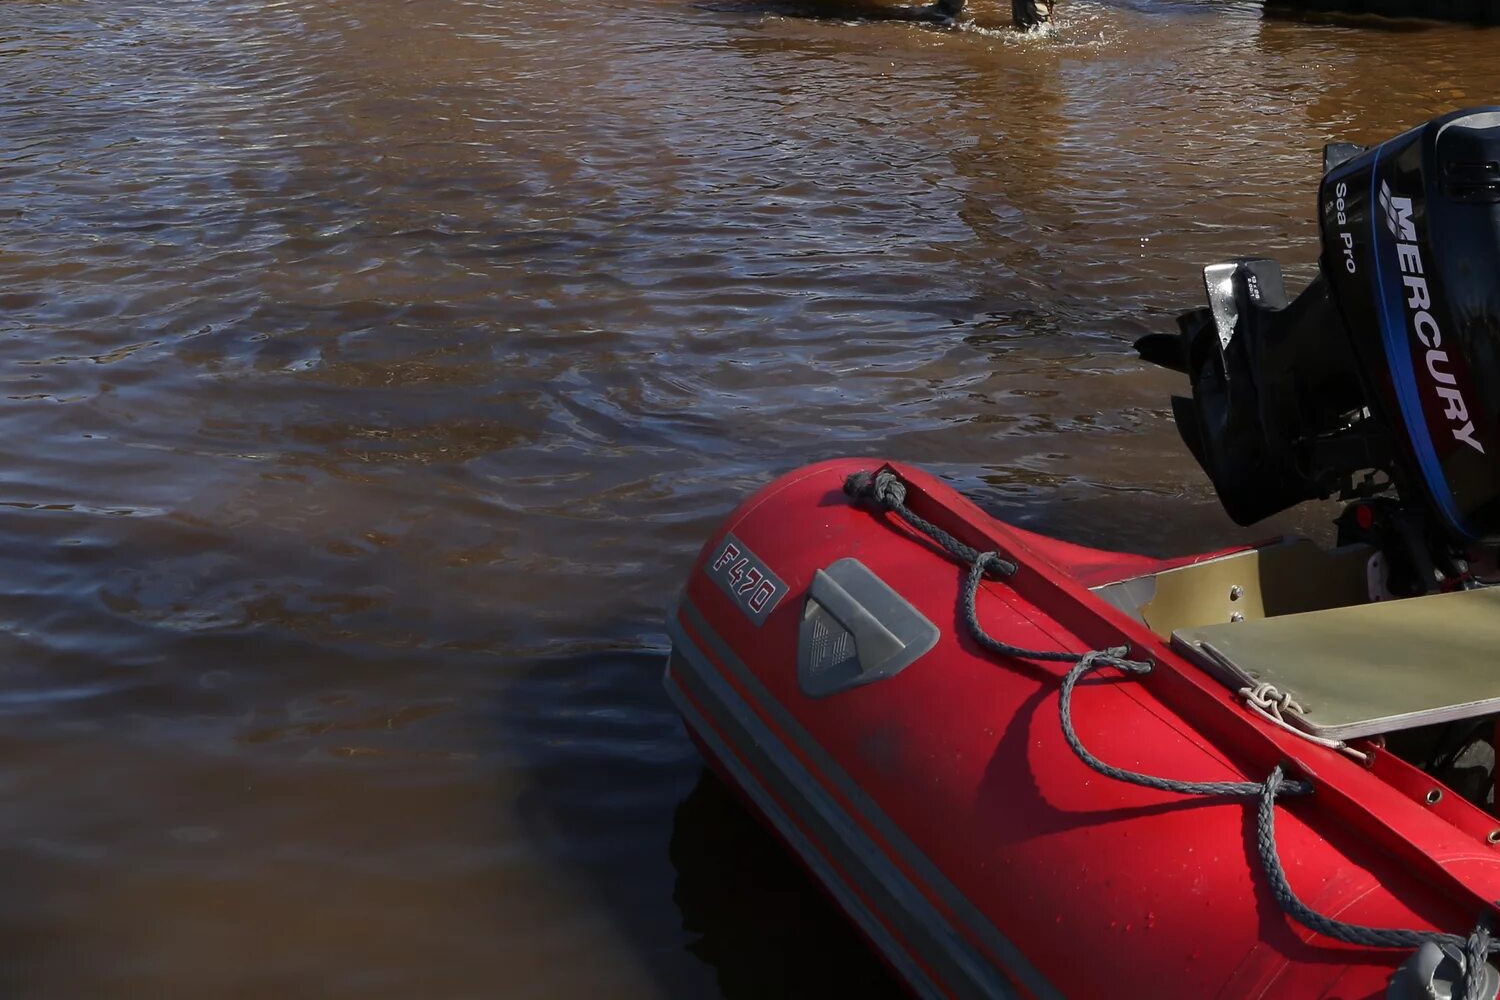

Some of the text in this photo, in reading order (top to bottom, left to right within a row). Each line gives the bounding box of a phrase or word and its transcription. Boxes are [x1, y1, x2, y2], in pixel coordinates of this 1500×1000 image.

[1335, 182, 1356, 274] Sea Pro
[1391, 196, 1486, 455] MERCURY
[713, 543, 777, 614] F470
